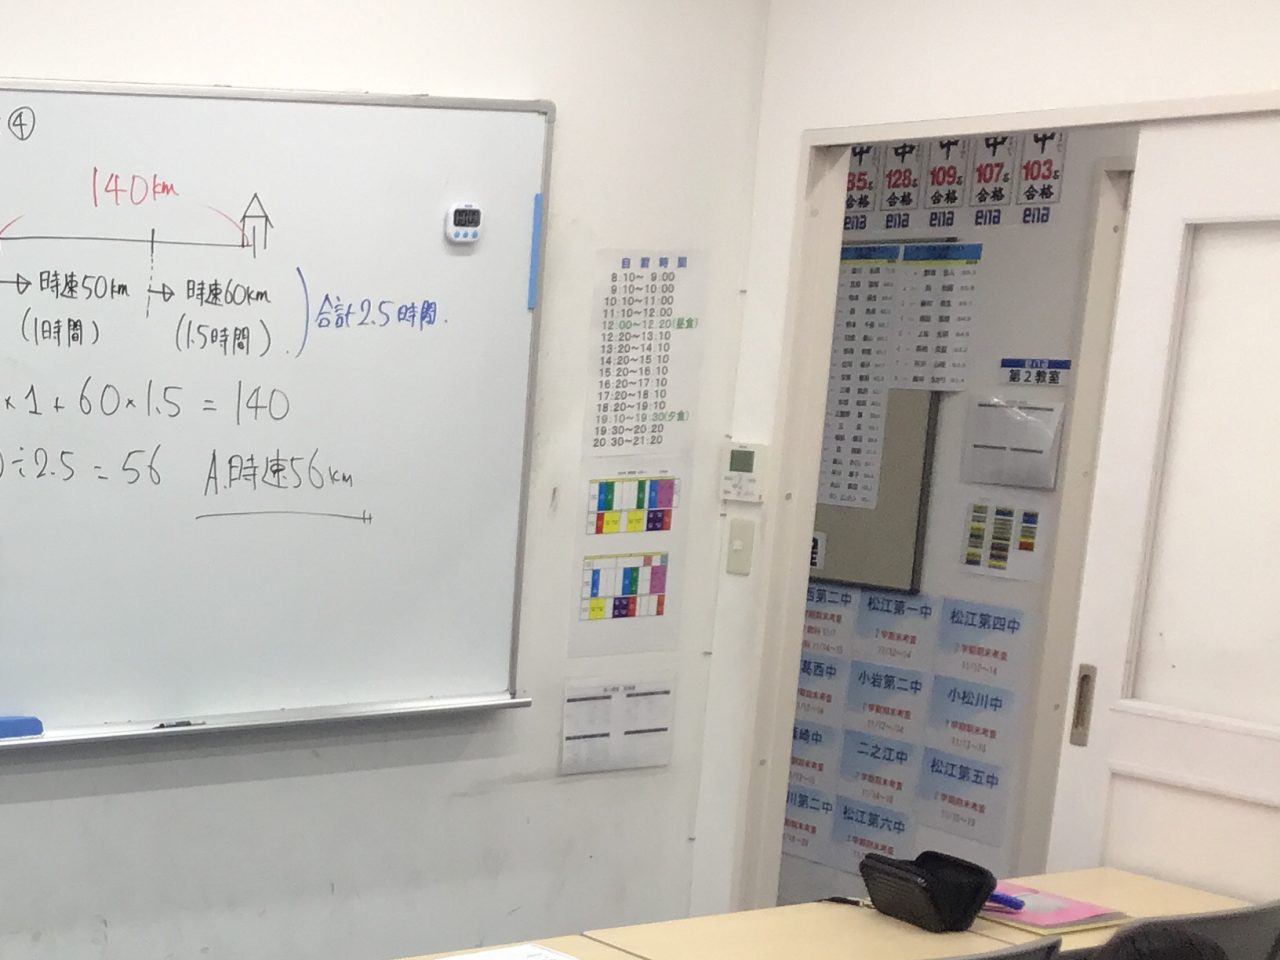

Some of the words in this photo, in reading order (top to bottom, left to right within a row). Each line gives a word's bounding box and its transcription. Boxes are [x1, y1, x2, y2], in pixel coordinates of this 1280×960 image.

[892, 143, 917, 164] 中
[93, 167, 180, 207] 140km
[930, 189, 959, 205] 合格
[976, 187, 1005, 203] 合格
[1023, 184, 1055, 201] 合格
[886, 191, 913, 207] 合格
[843, 214, 868, 231] ena
[885, 212, 910, 229] ena
[928, 210, 955, 227] ena
[975, 208, 1002, 226] ena
[1022, 206, 1051, 224] ena
[38, 270, 131, 301] 時速50km
[185, 278, 273, 305] 時速60km
[21, 306, 100, 346] (1時間)
[1024, 359, 1050, 369] ena
[1008, 368, 1061, 385] 第2教室
[866, 595, 933, 619] 松江第一中
[950, 607, 1021, 635] 松江第四中
[858, 669, 923, 695] 小岩第二中
[947, 686, 1003, 712] 小松川中
[856, 741, 909, 766] 二之江中
[930, 757, 1000, 790] 松江第五中
[842, 805, 906, 835] 松江第六中
